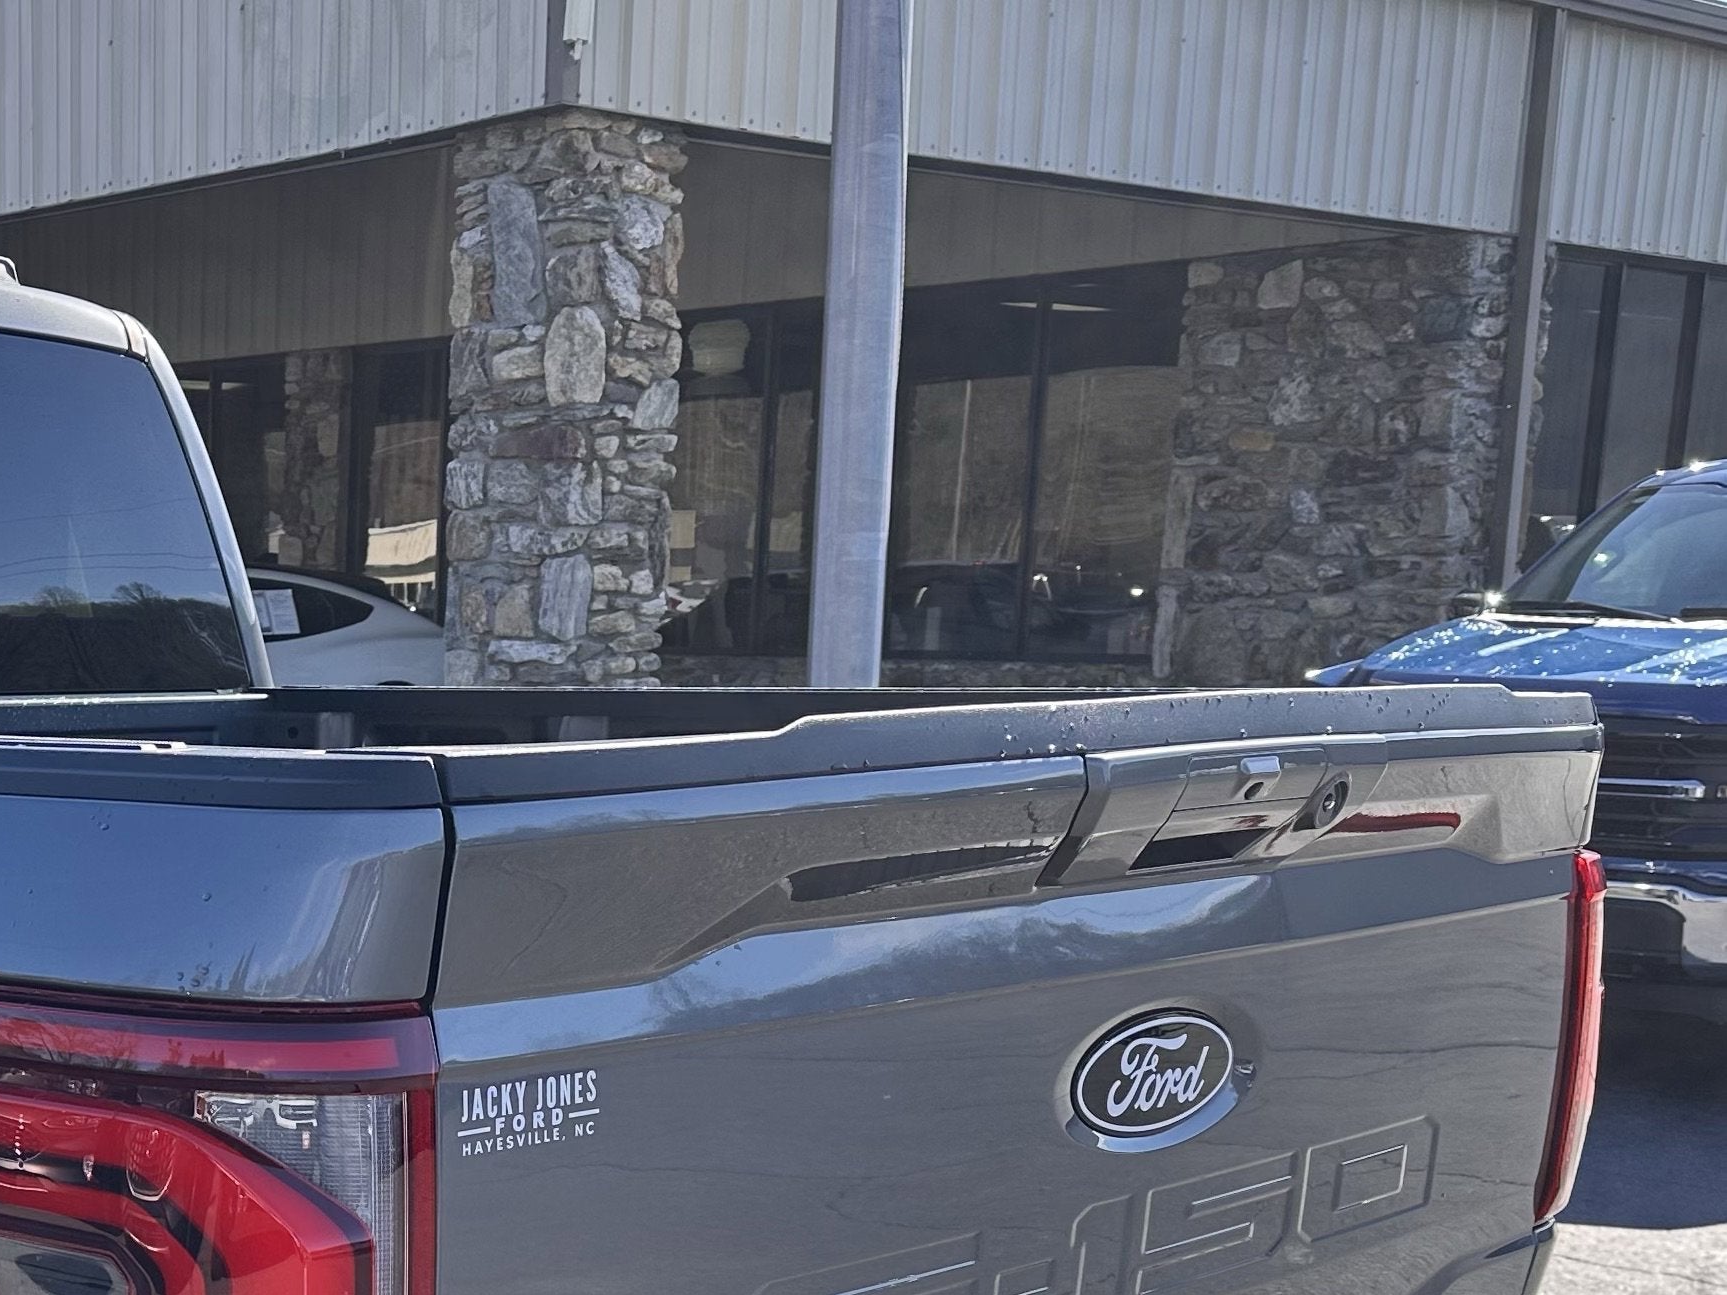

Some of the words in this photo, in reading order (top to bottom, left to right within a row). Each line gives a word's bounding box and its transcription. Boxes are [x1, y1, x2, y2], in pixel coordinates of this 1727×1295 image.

[461, 1080, 527, 1123] JACKY
[536, 1069, 597, 1111] JONES
[1106, 1033, 1210, 1117] Ford
[462, 1127, 566, 1157] HAYESVILLE,
[574, 1121, 595, 1137] NC
[495, 1107, 564, 1135] FORD
